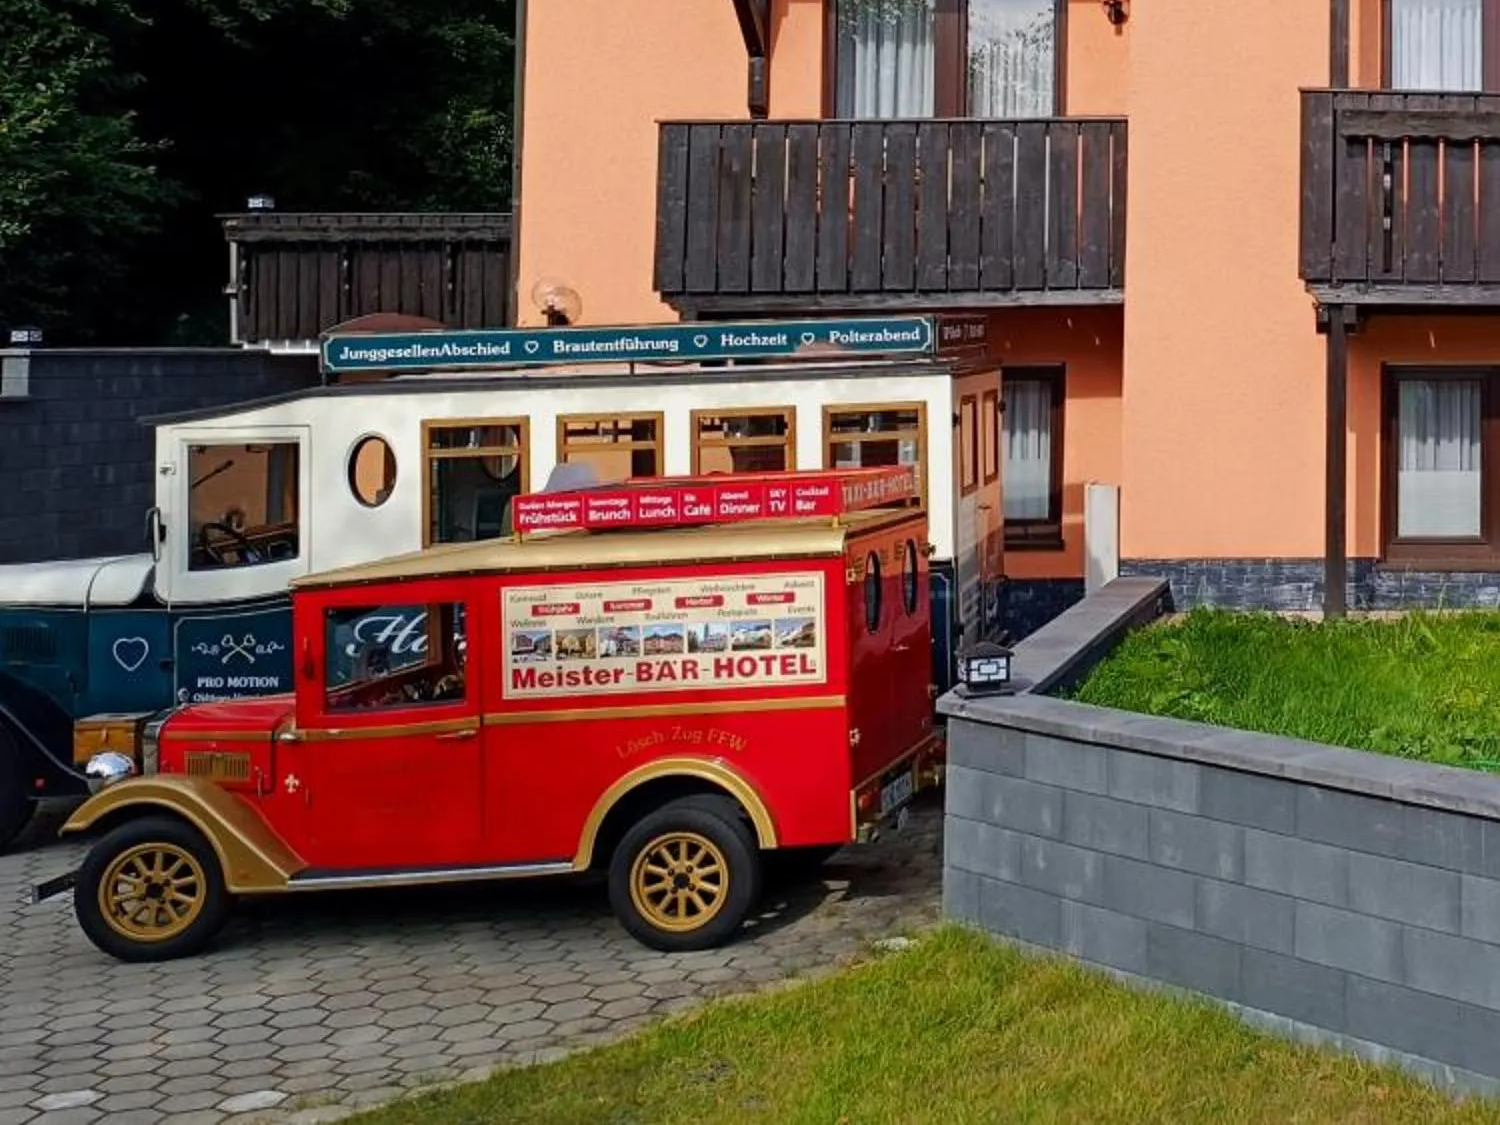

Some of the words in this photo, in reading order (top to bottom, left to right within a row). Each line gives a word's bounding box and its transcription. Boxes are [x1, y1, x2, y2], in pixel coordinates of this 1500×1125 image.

[339, 341, 511, 361] JunggesellenAbschied
[553, 335, 679, 354] Brautentführung
[721, 333, 787, 347] Hochzeit
[829, 328, 921, 344] Polterabend
[719, 502, 760, 515] Dinner
[769, 500, 786, 512] TV
[795, 499, 817, 511] Bar
[519, 511, 577, 524] Frühstück
[588, 508, 631, 521] Brunch
[639, 506, 676, 518] Lunch
[197, 676, 224, 688] PRO
[227, 676, 279, 688] MOTION
